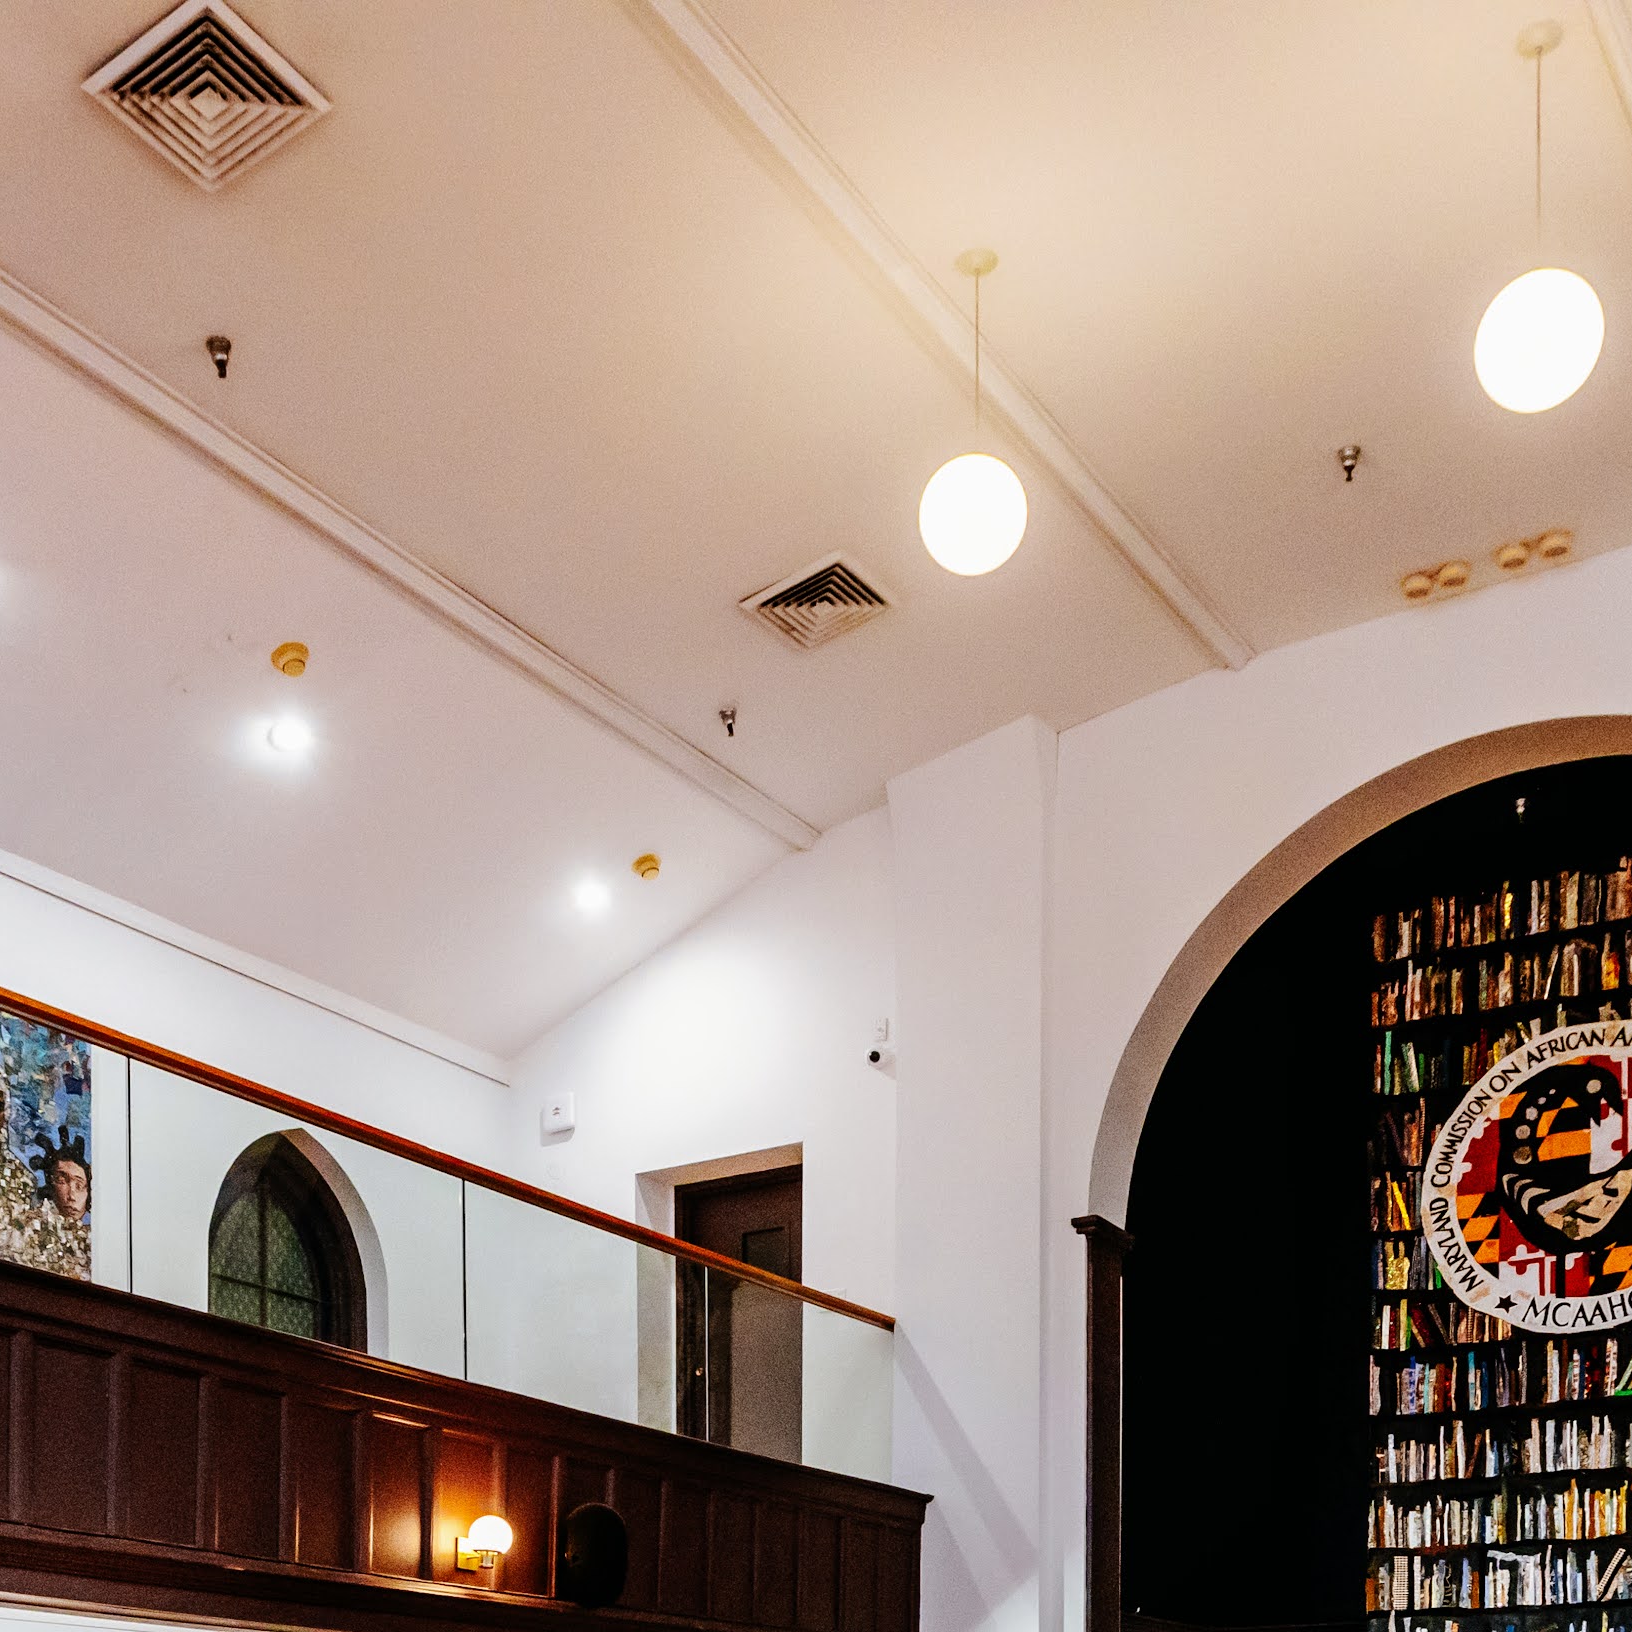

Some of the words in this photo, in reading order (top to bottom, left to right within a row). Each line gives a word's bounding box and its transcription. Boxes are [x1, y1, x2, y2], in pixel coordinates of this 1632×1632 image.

[1489, 1061, 1521, 1093] ON
[1526, 1029, 1605, 1070] AFRICAN
[1431, 1088, 1493, 1187] COMMISSION
[1429, 1197, 1485, 1292] MARYLAND
